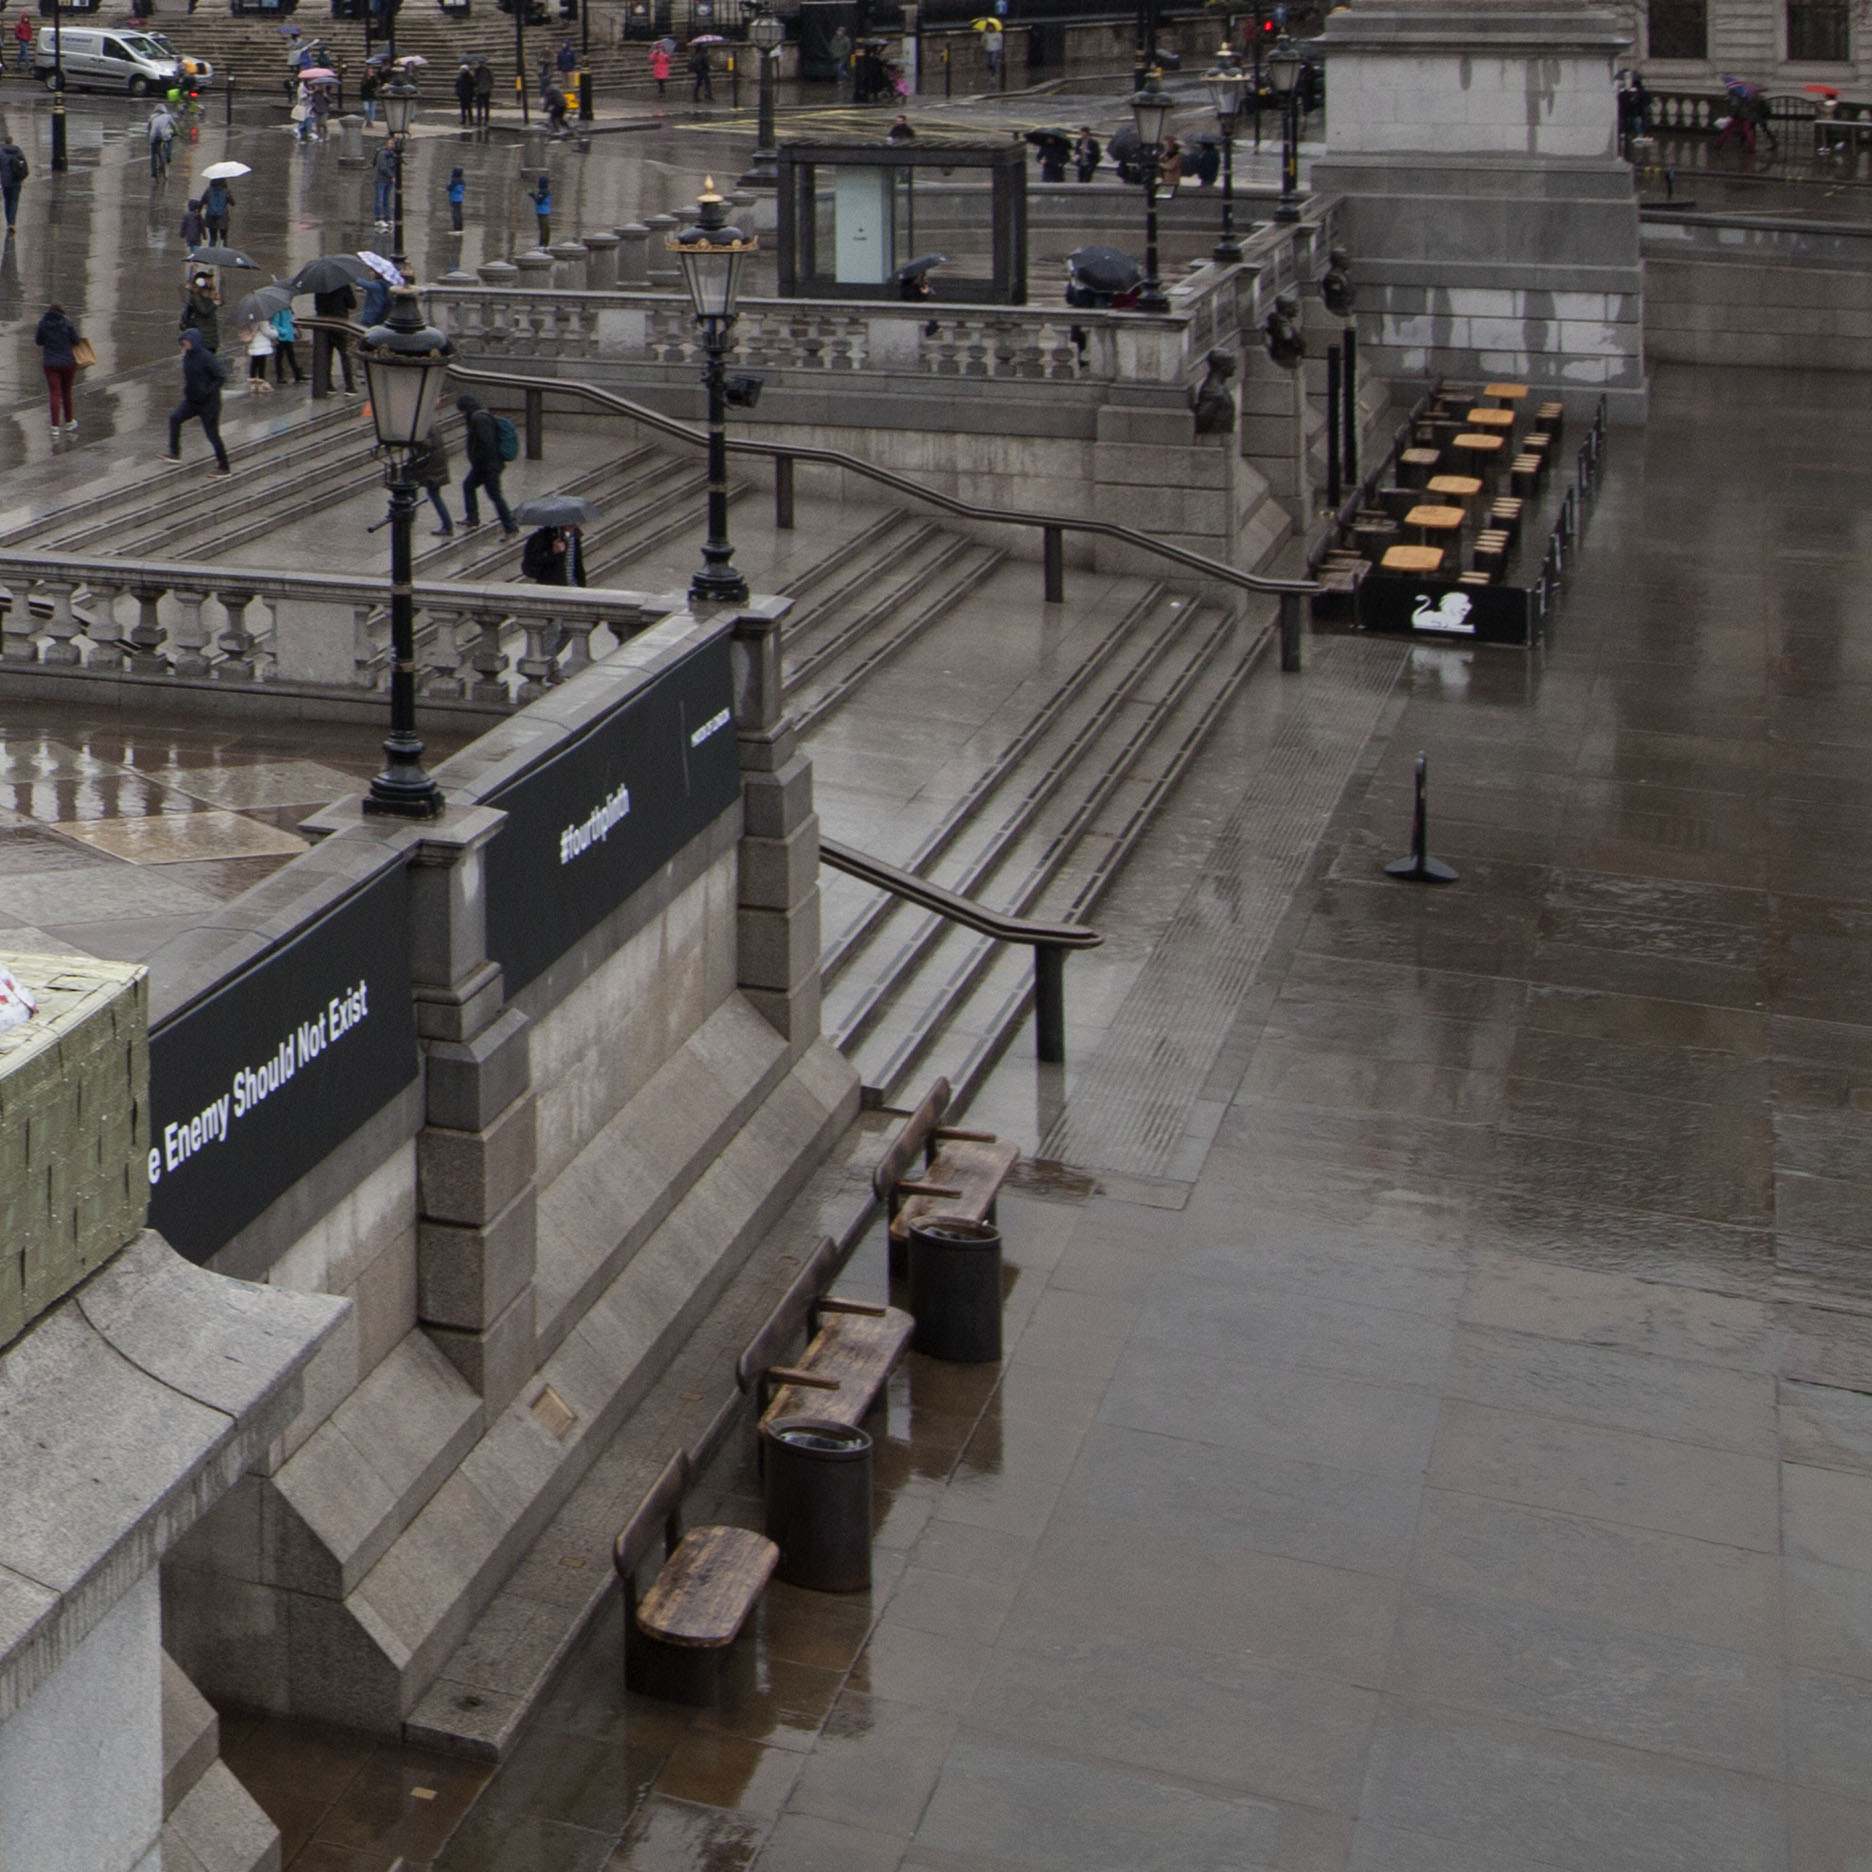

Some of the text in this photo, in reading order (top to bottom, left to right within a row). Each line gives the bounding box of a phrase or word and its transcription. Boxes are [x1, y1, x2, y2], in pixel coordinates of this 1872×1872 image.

[164, 1094, 230, 1172] Enemy
[233, 1032, 296, 1118] Should
[297, 1011, 328, 1068] Not
[328, 979, 369, 1042] Exist
